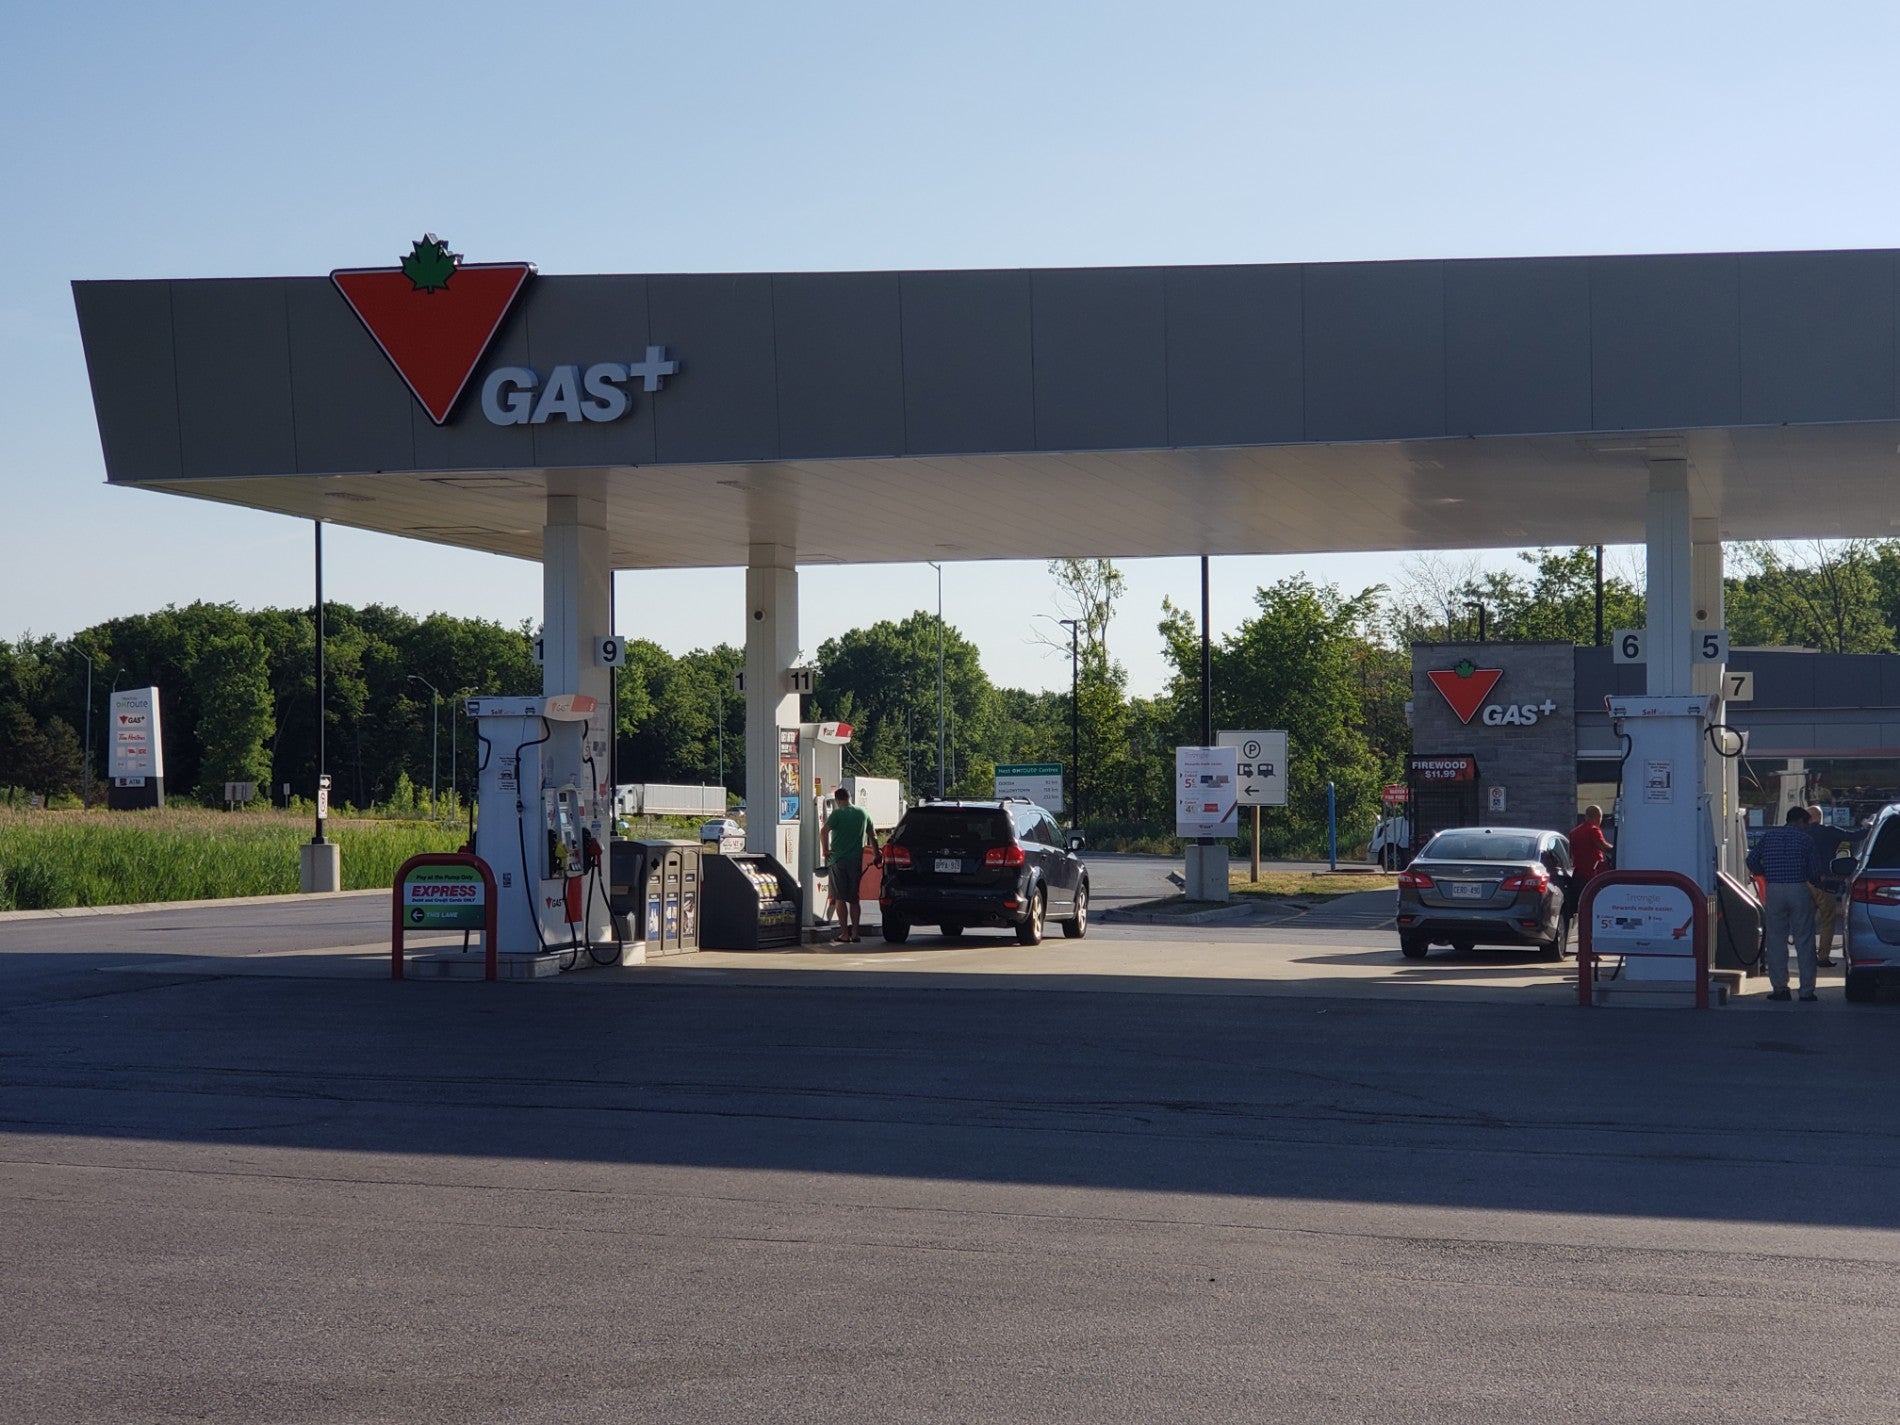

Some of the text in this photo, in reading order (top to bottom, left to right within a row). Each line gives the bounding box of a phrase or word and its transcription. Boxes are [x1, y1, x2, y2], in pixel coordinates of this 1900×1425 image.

[481, 345, 680, 426] GAS+
[534, 638, 544, 660] 1
[602, 640, 617, 662] 9
[1622, 634, 1640, 659] 6
[1702, 634, 1719, 659] 5
[735, 672, 746, 691] 1
[791, 672, 809, 690] 11
[1730, 676, 1745, 696] 7
[1482, 699, 1557, 726] GAS+
[1412, 761, 1467, 770] FIREWOOD
[1425, 770, 1456, 779] $11.99
[412, 885, 476, 897] EXPRESS
